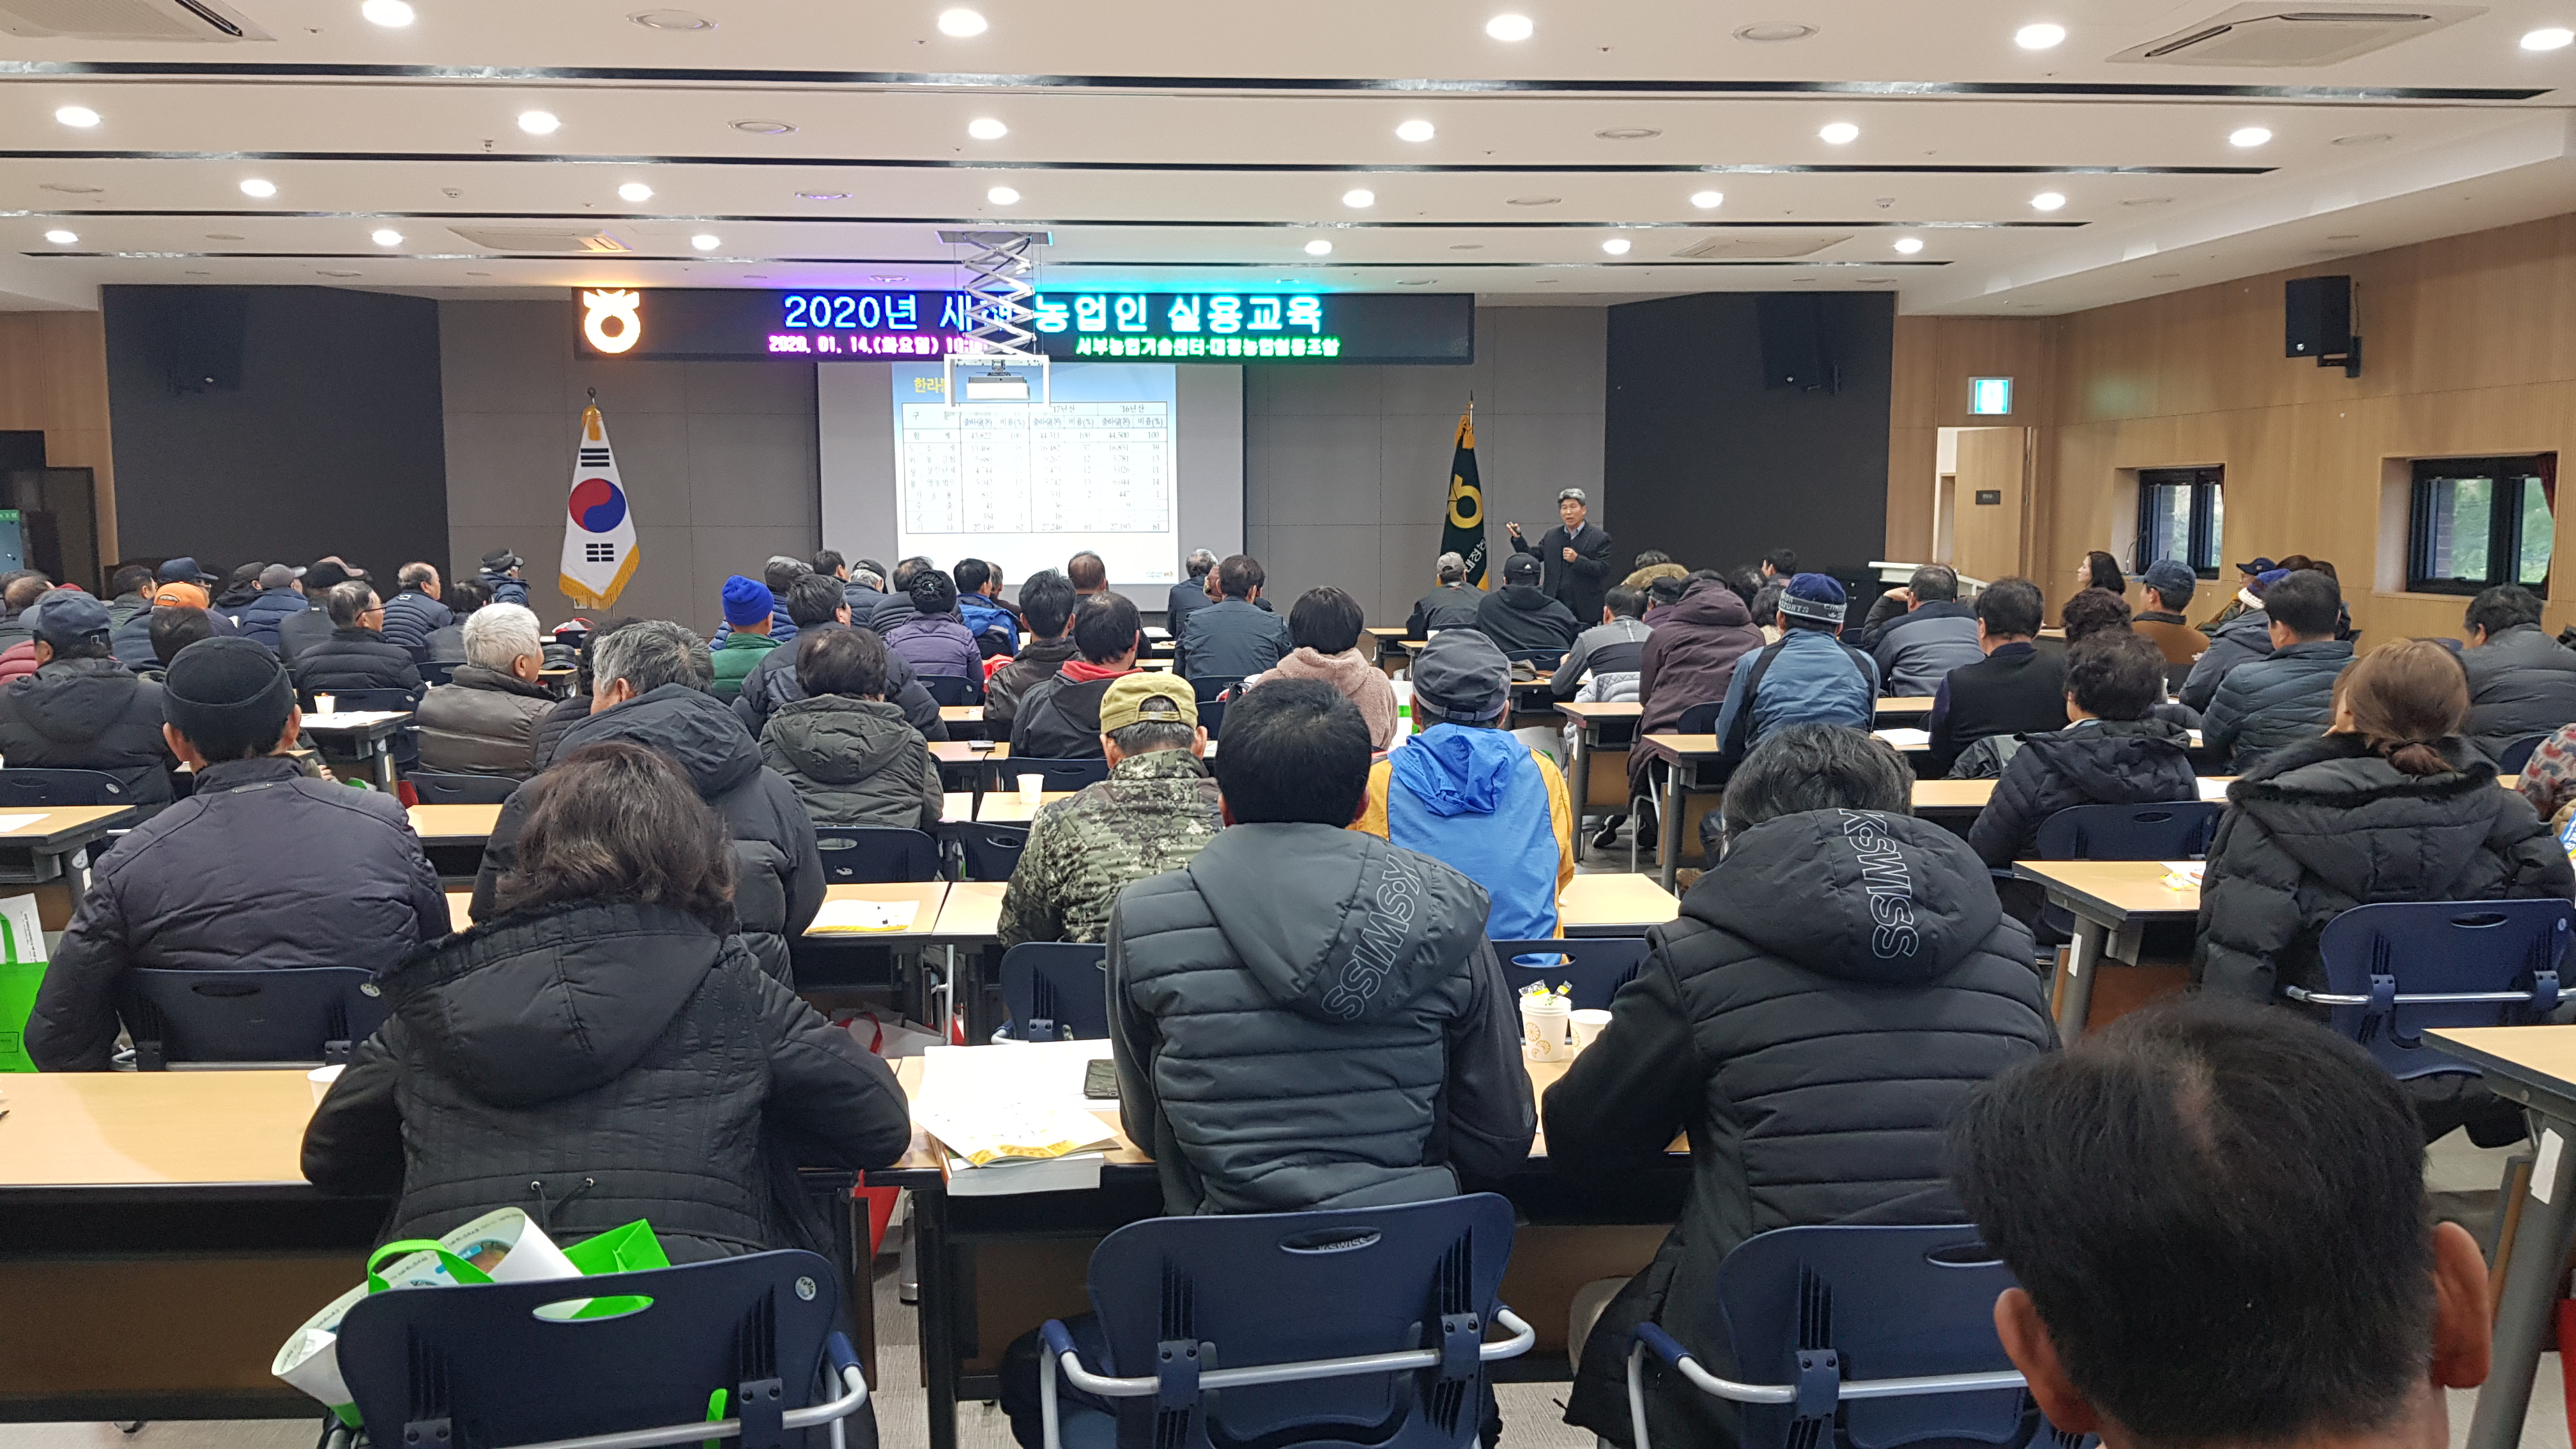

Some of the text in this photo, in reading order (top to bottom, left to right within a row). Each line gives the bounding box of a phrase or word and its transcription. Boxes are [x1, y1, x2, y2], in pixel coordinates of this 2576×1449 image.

[784, 294, 918, 330] 2020년
[1034, 295, 1148, 333] 농업인
[1168, 295, 1323, 334] 실용교육
[1153, 523, 1160, 531] 61
